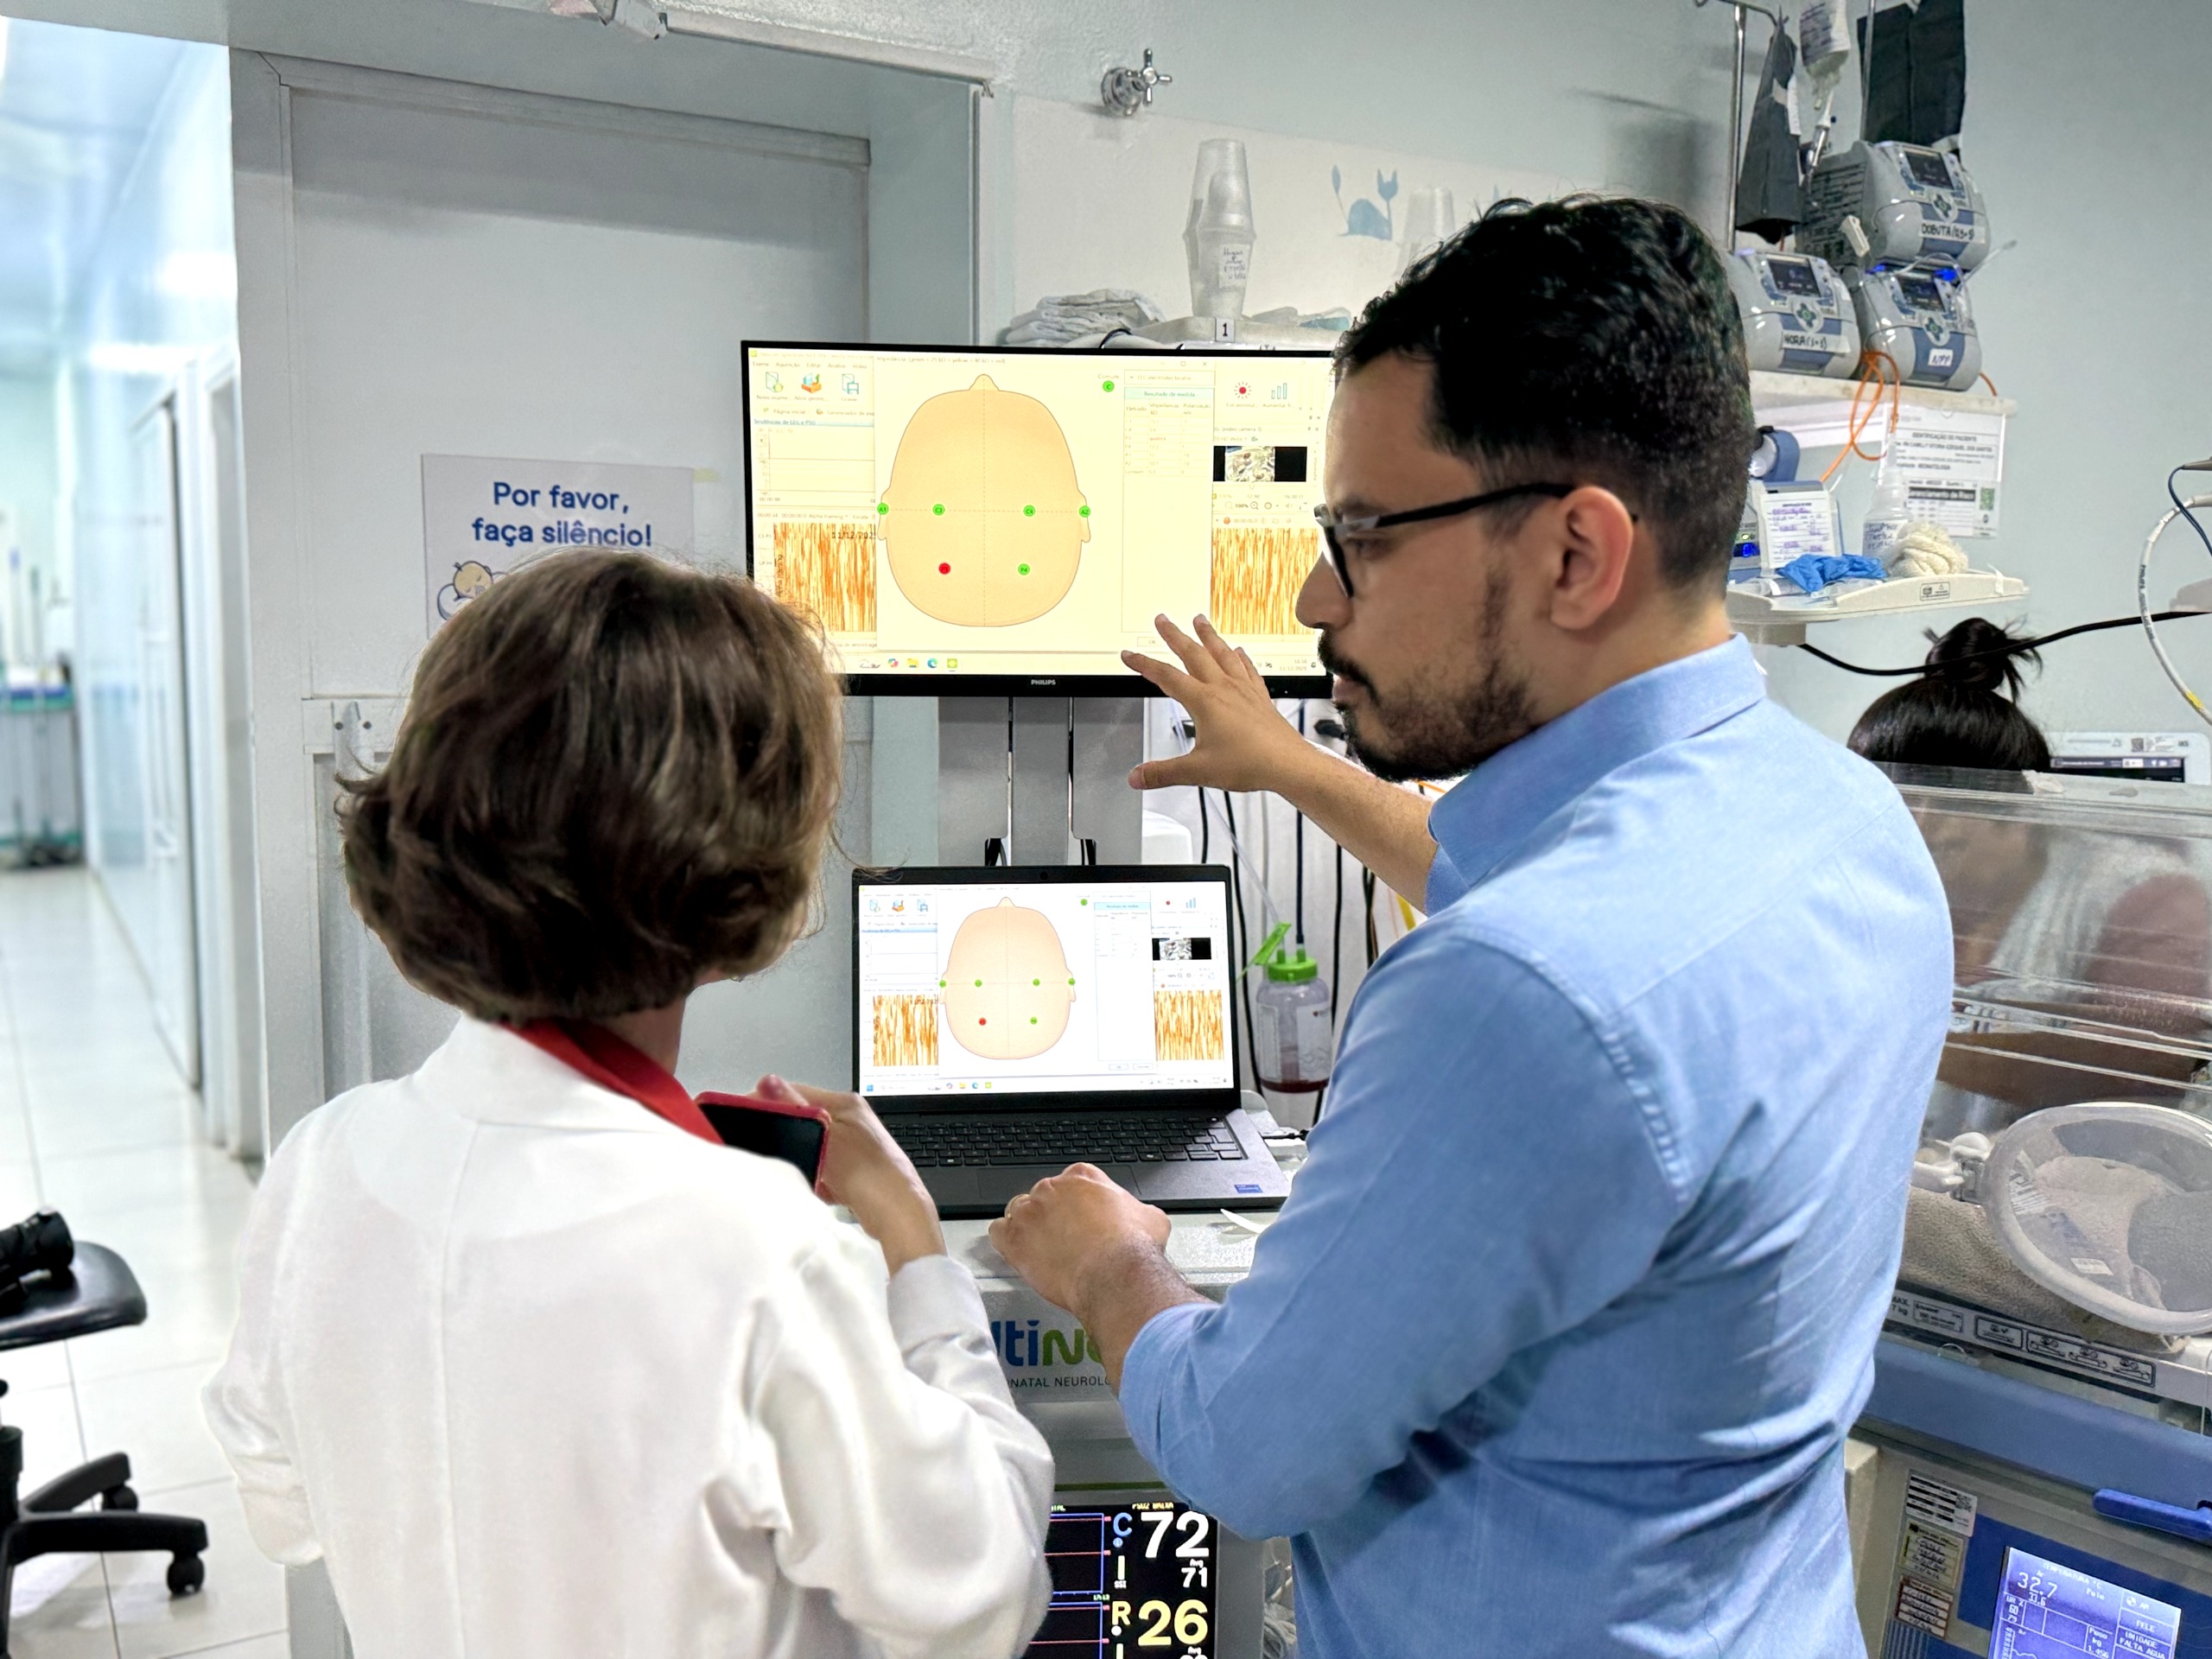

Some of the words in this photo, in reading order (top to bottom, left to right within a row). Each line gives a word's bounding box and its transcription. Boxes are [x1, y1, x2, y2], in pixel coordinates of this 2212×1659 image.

[1222, 322, 1228, 337] 1
[493, 482, 541, 507] Por
[550, 485, 630, 514] favor,
[472, 518, 533, 547] faça
[542, 520, 652, 547] silêncio!
[1008, 1376, 1050, 1388] NATAL
[1113, 1512, 1133, 1536] C
[1141, 1510, 1210, 1559] 72
[1181, 1567, 1208, 1588] 71
[2017, 1572, 2058, 1599] 32.7
[1111, 1600, 1131, 1626] R
[1138, 1599, 1208, 1646] 26
[2092, 1637, 2102, 1647] kg
[2119, 1637, 2144, 1652] FALTA
